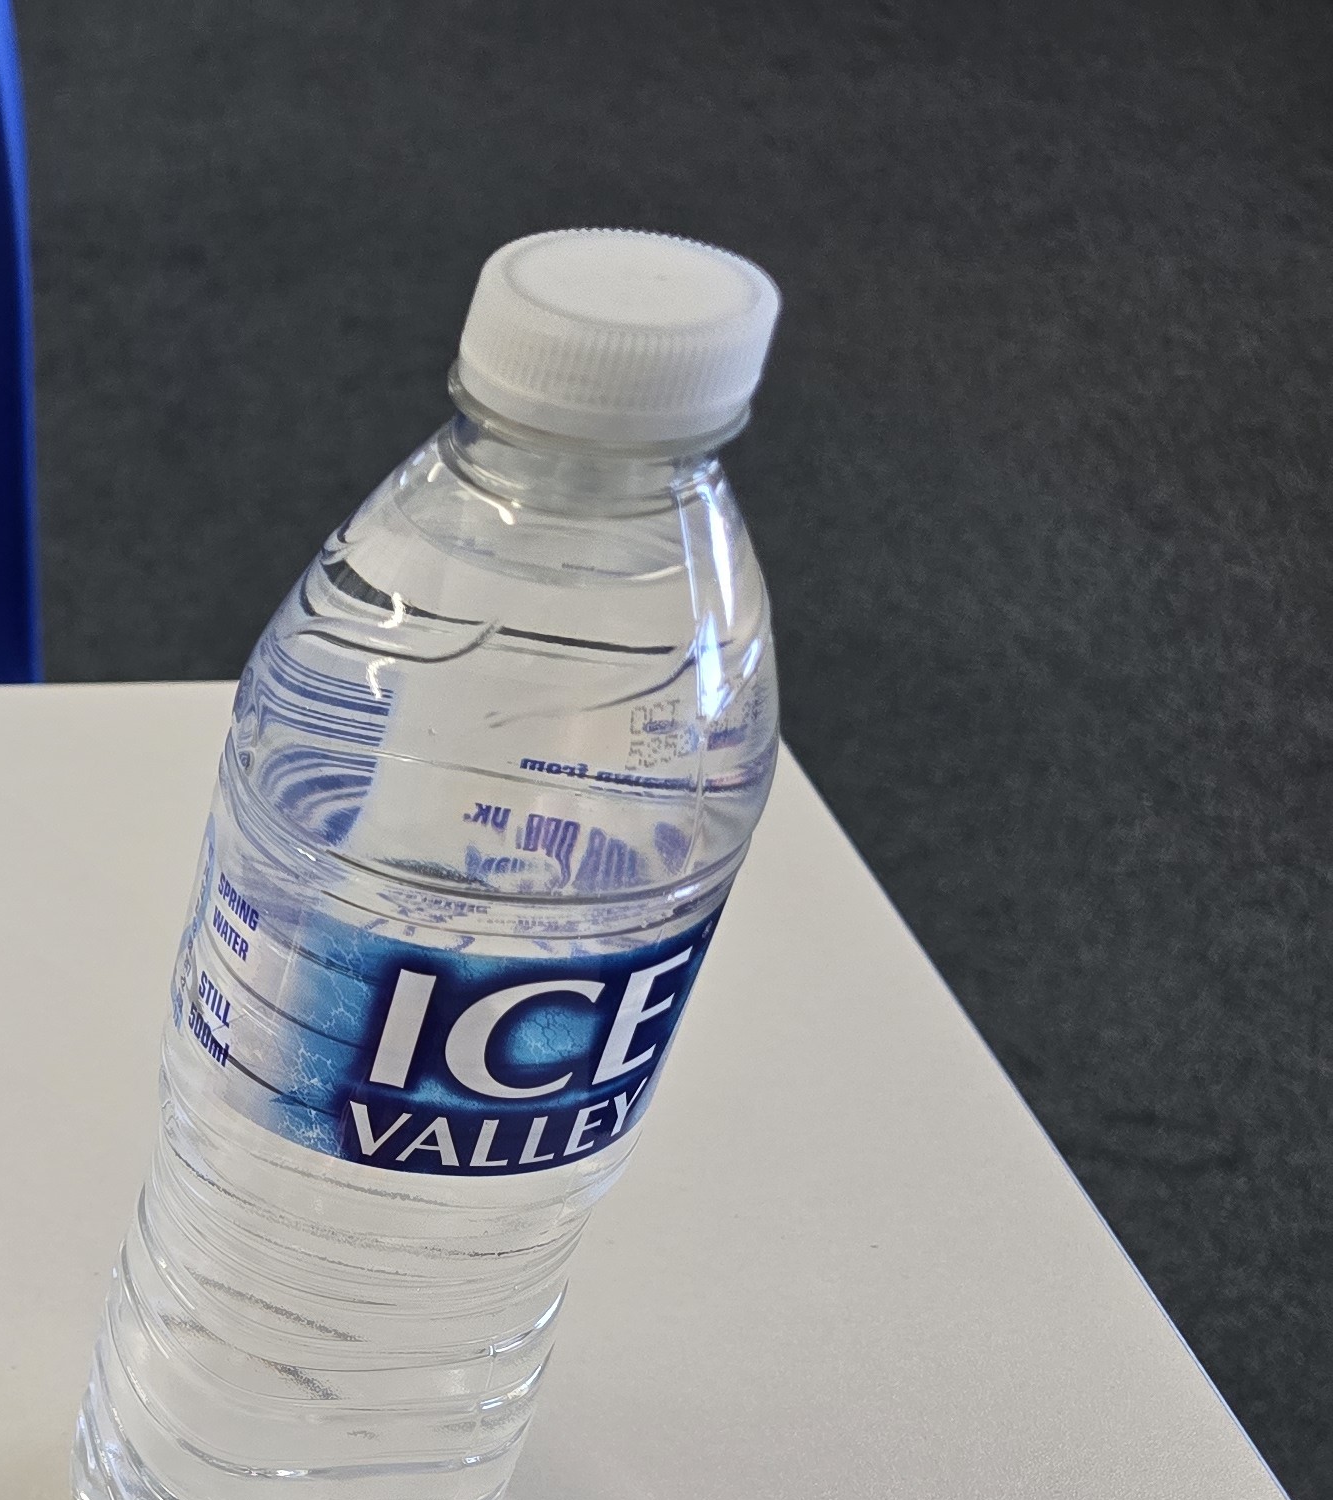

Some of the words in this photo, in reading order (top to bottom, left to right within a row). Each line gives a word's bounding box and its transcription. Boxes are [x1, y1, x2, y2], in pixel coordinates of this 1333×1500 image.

[213, 905, 249, 961] WATER
[218, 872, 260, 931] SPRING
[198, 971, 230, 1028] STILL
[368, 944, 693, 1099] ICE
[188, 1001, 230, 1068] 500ml
[348, 1076, 649, 1169] VALLEY
